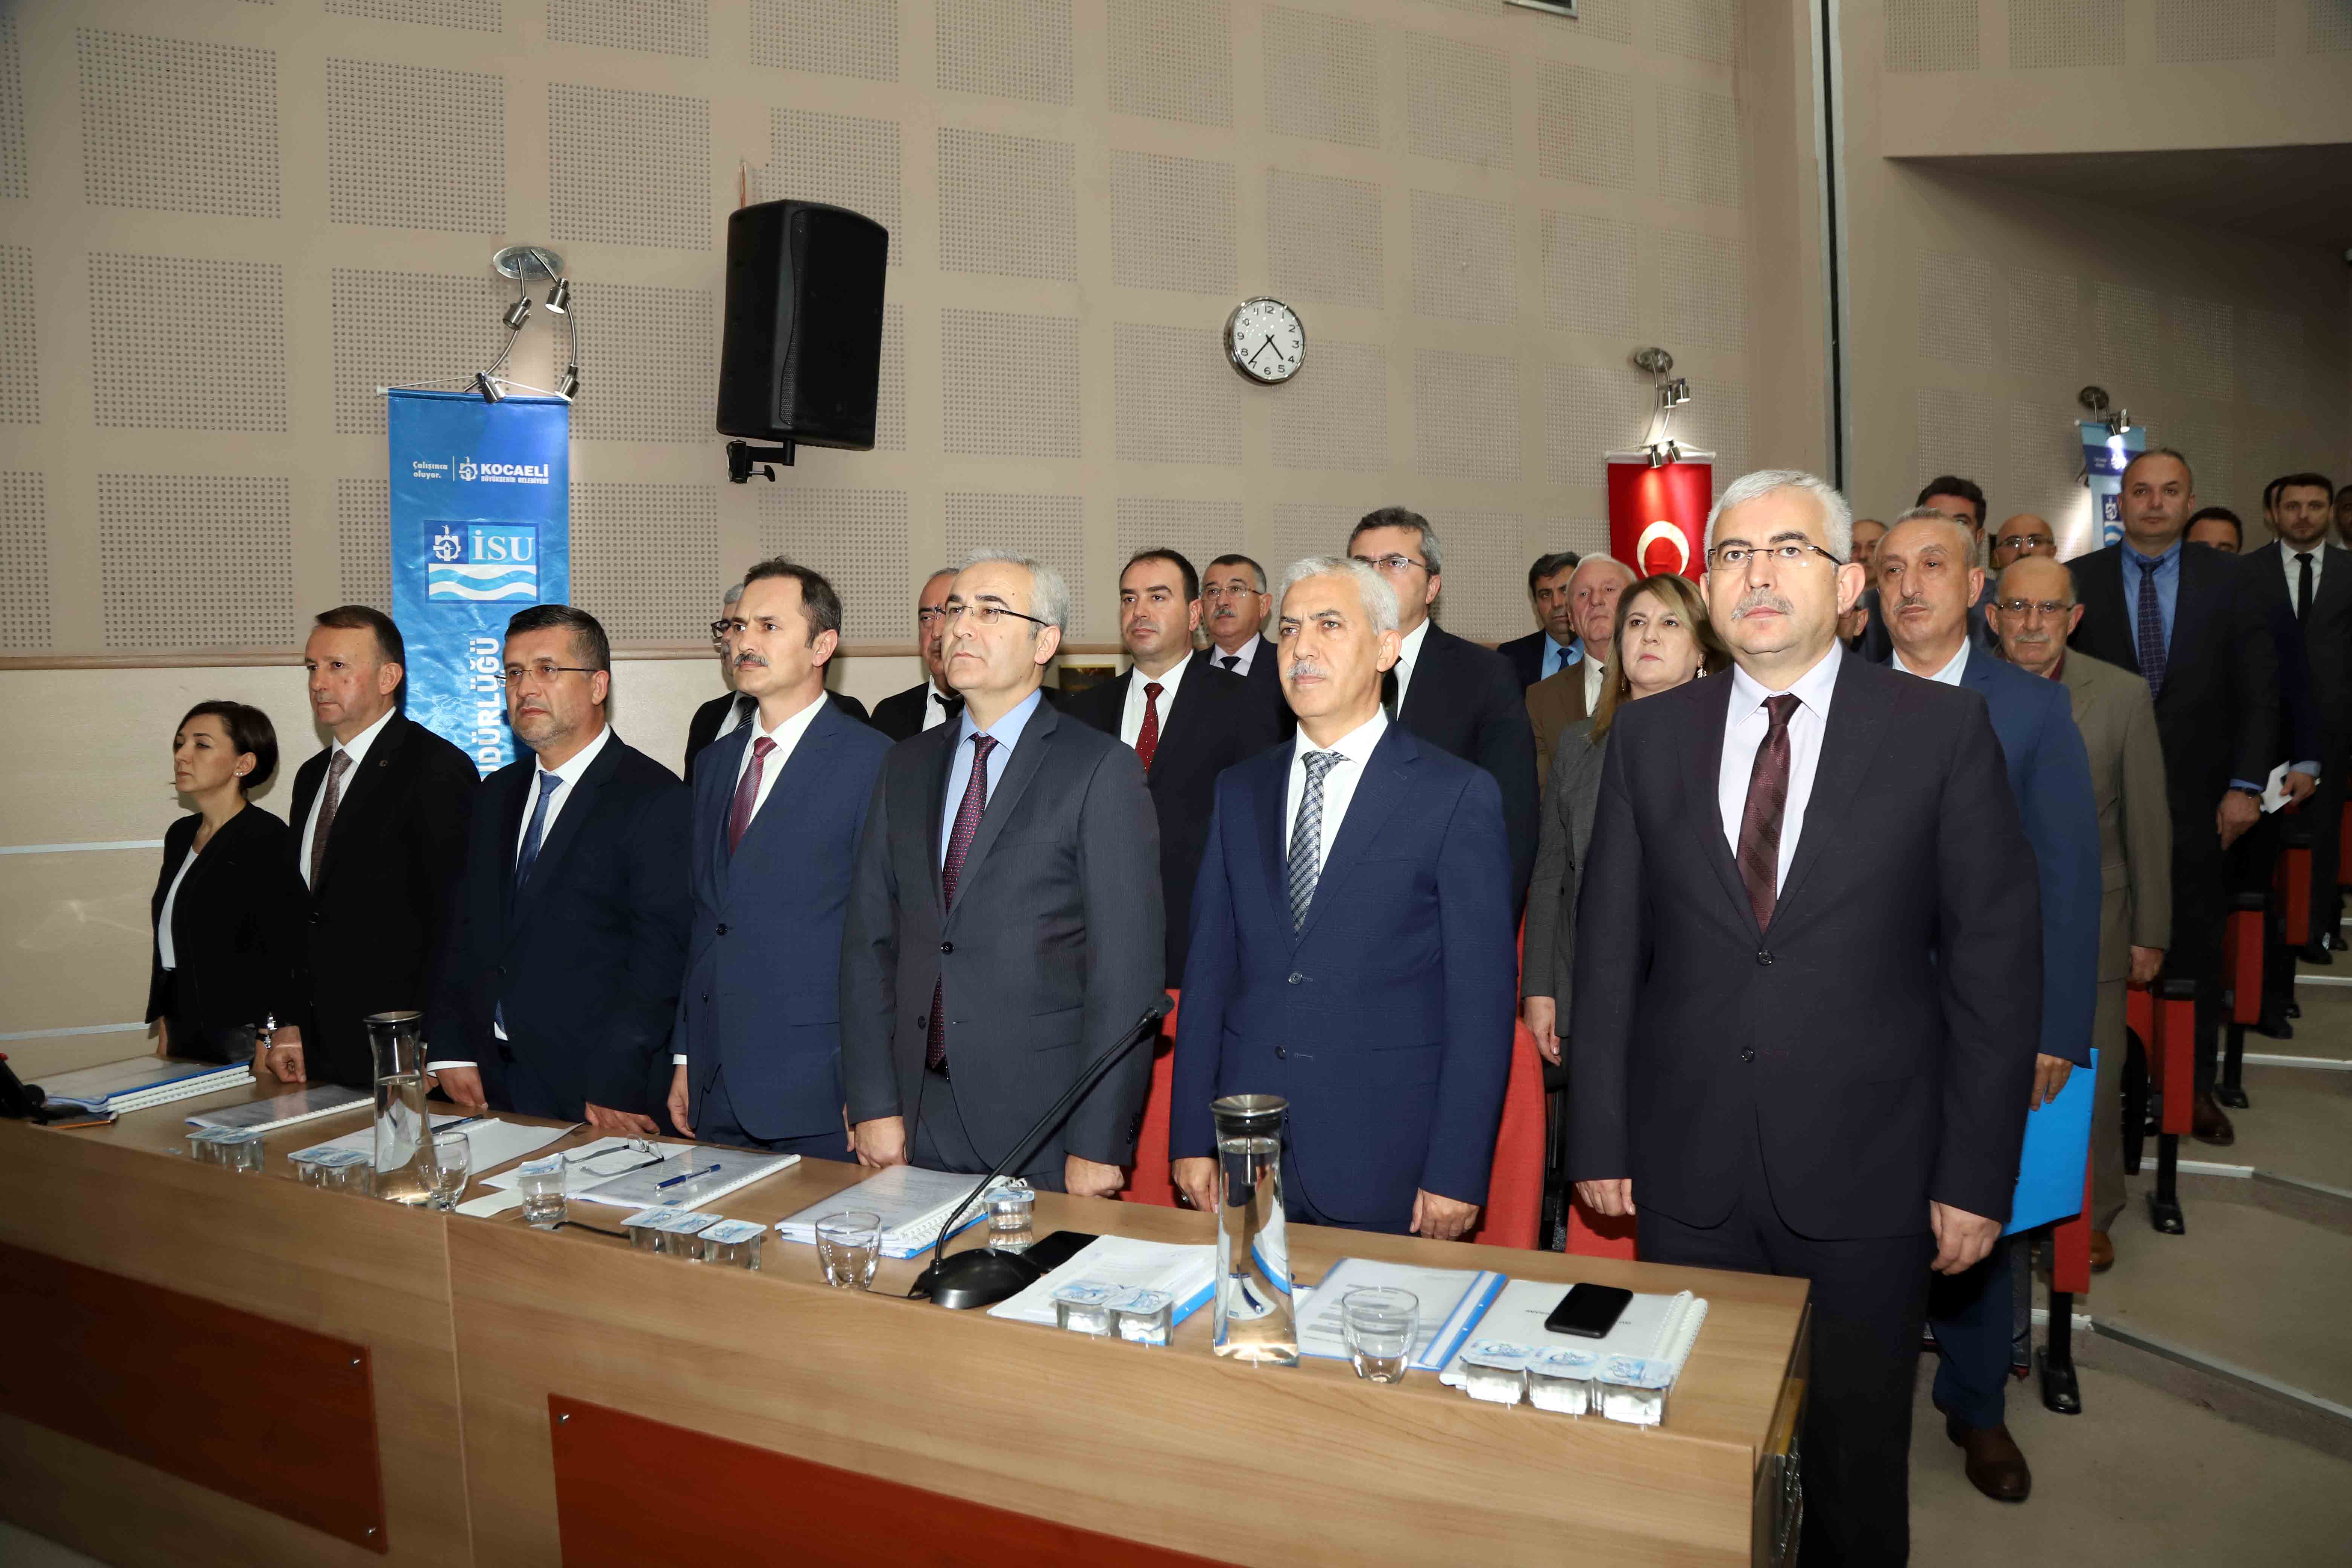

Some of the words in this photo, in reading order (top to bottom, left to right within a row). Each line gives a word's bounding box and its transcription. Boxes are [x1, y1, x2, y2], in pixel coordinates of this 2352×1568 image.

[1265, 306, 1274, 314] 12
[1288, 325, 1295, 333] 2
[1292, 340, 1300, 349] 3
[1250, 360, 1257, 369] 7
[1278, 364, 1285, 373] 5
[413, 471, 441, 479] oluyor.
[481, 464, 549, 477] KOCAELİ
[472, 530, 534, 560] İSU
